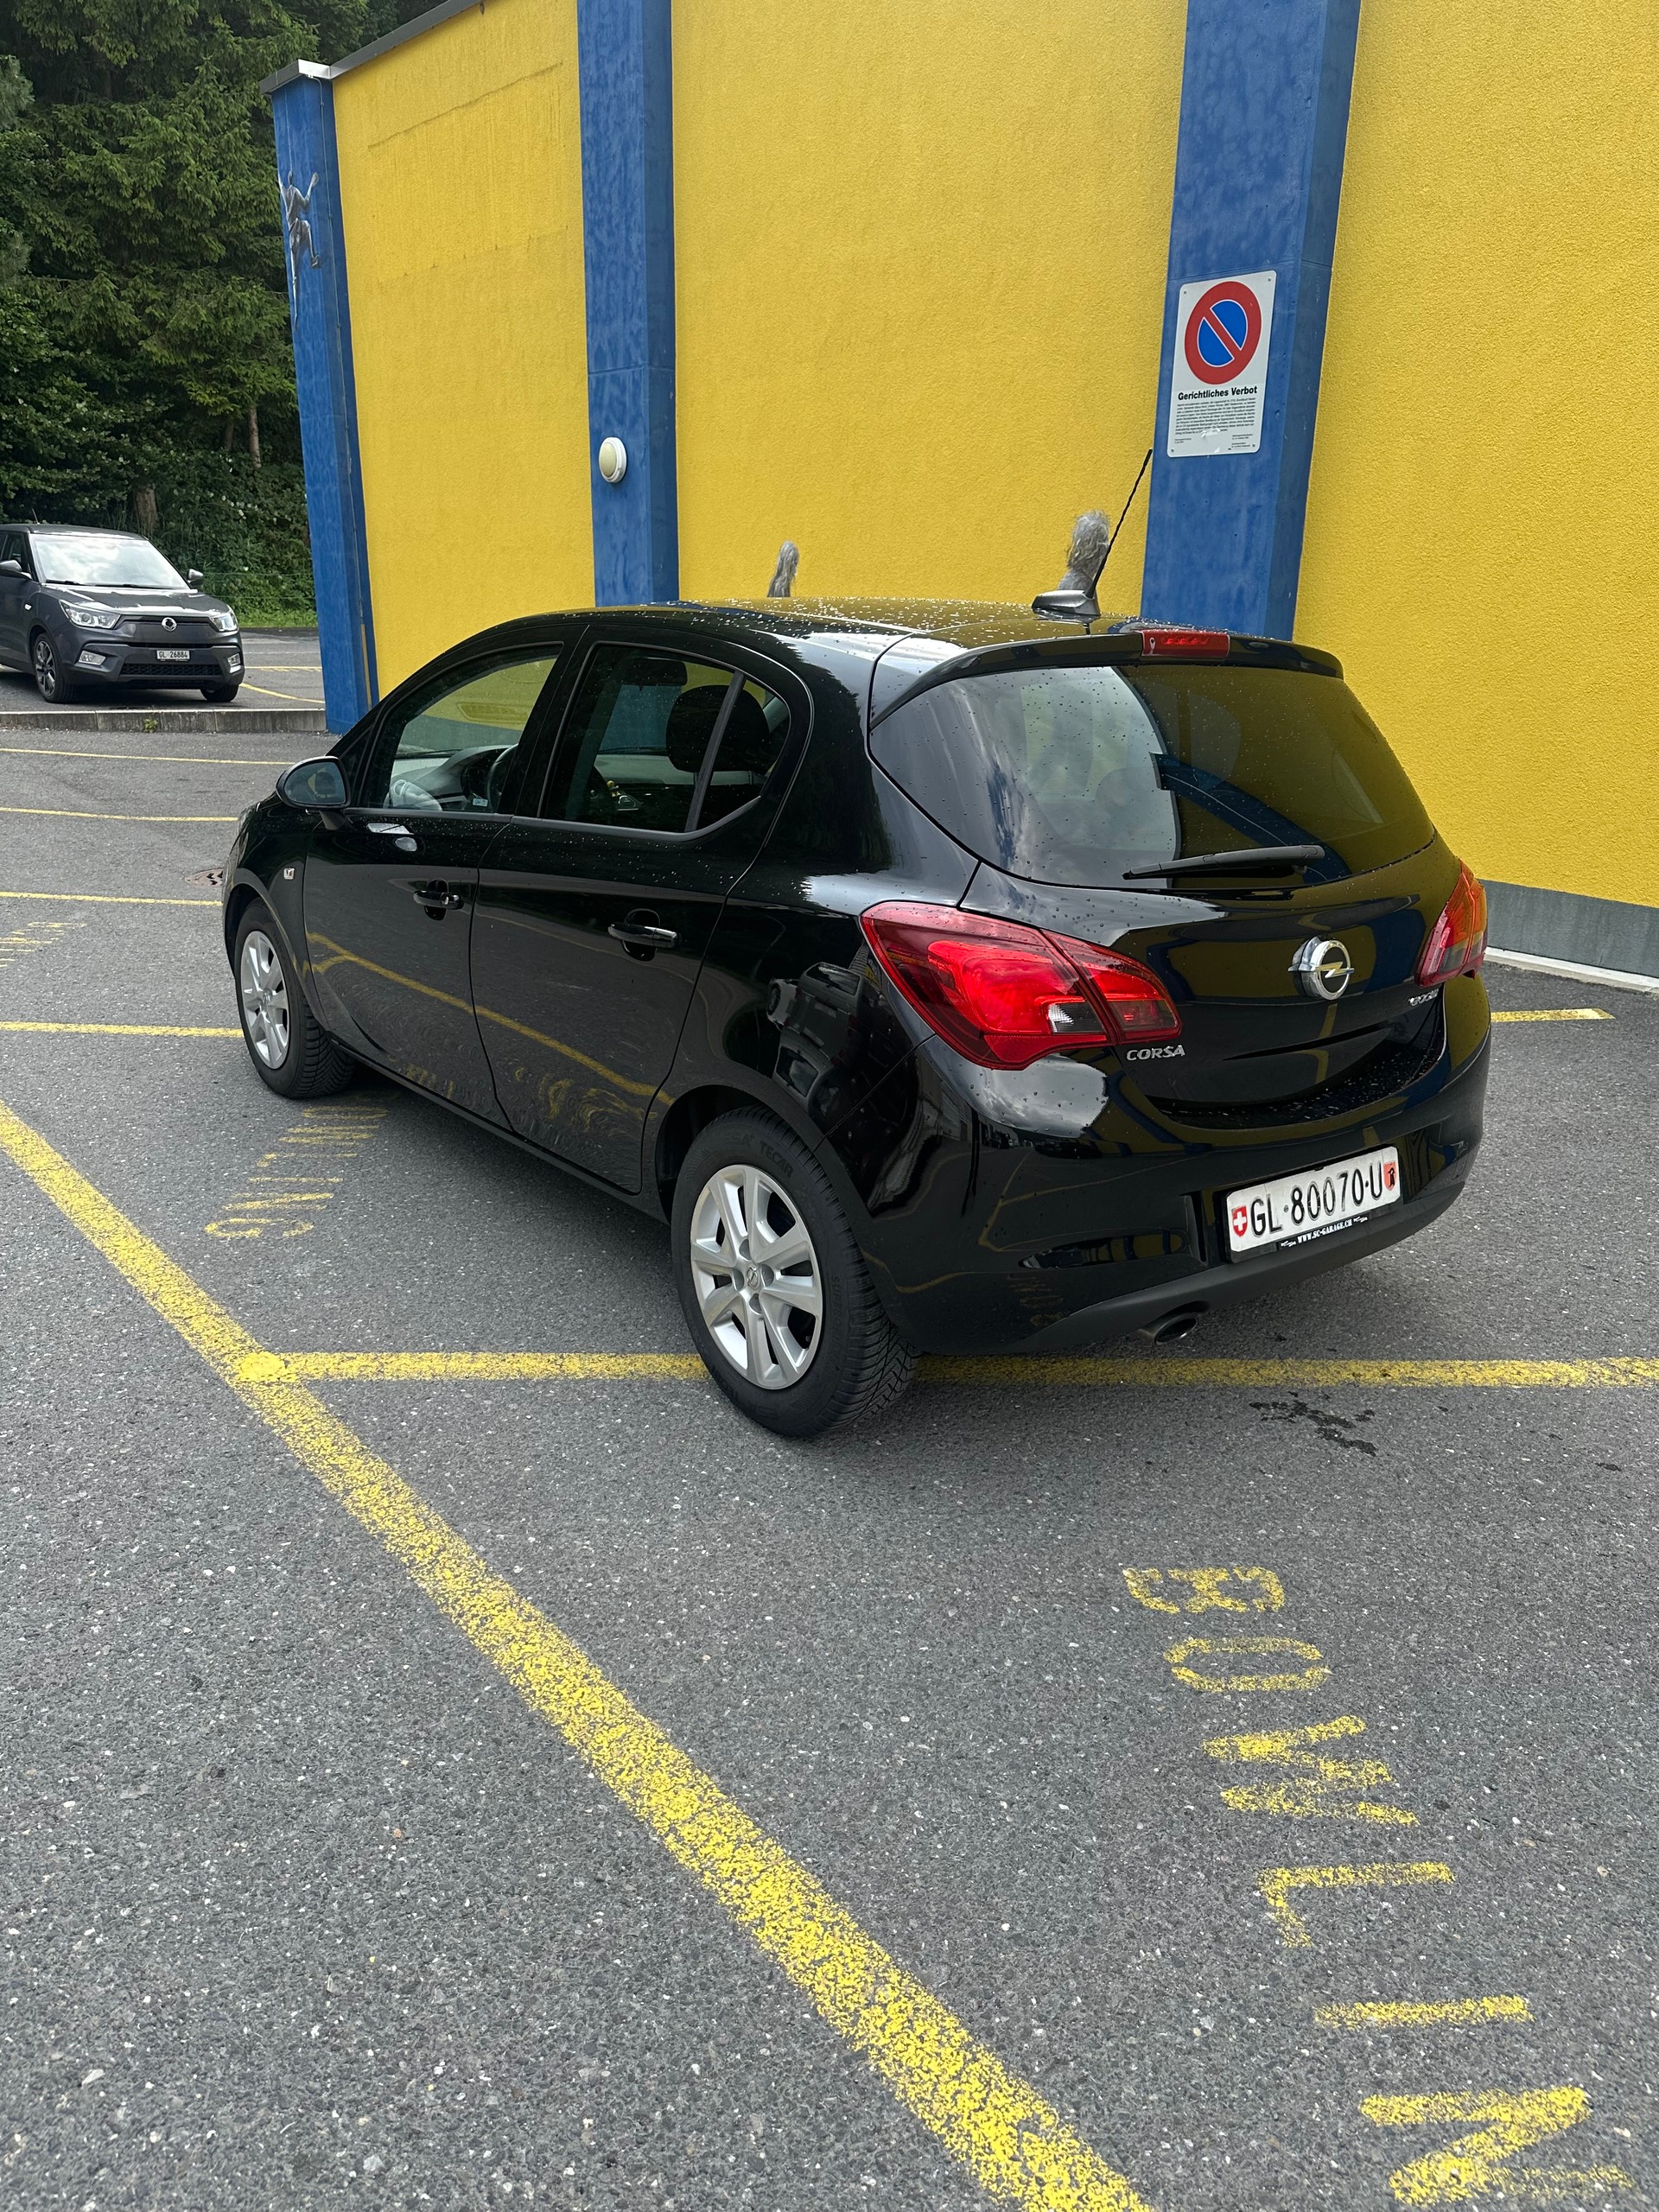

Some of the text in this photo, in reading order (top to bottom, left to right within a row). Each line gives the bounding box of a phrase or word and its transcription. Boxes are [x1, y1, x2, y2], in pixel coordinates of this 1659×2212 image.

[1178, 385, 1258, 400] Gerichtliches Verbot
[1126, 1045, 1185, 1061] CORSA
[760, 1140, 794, 1179] TECAR
[1297, 1218, 1353, 1243] WWW.SC-GARAGE.CH
